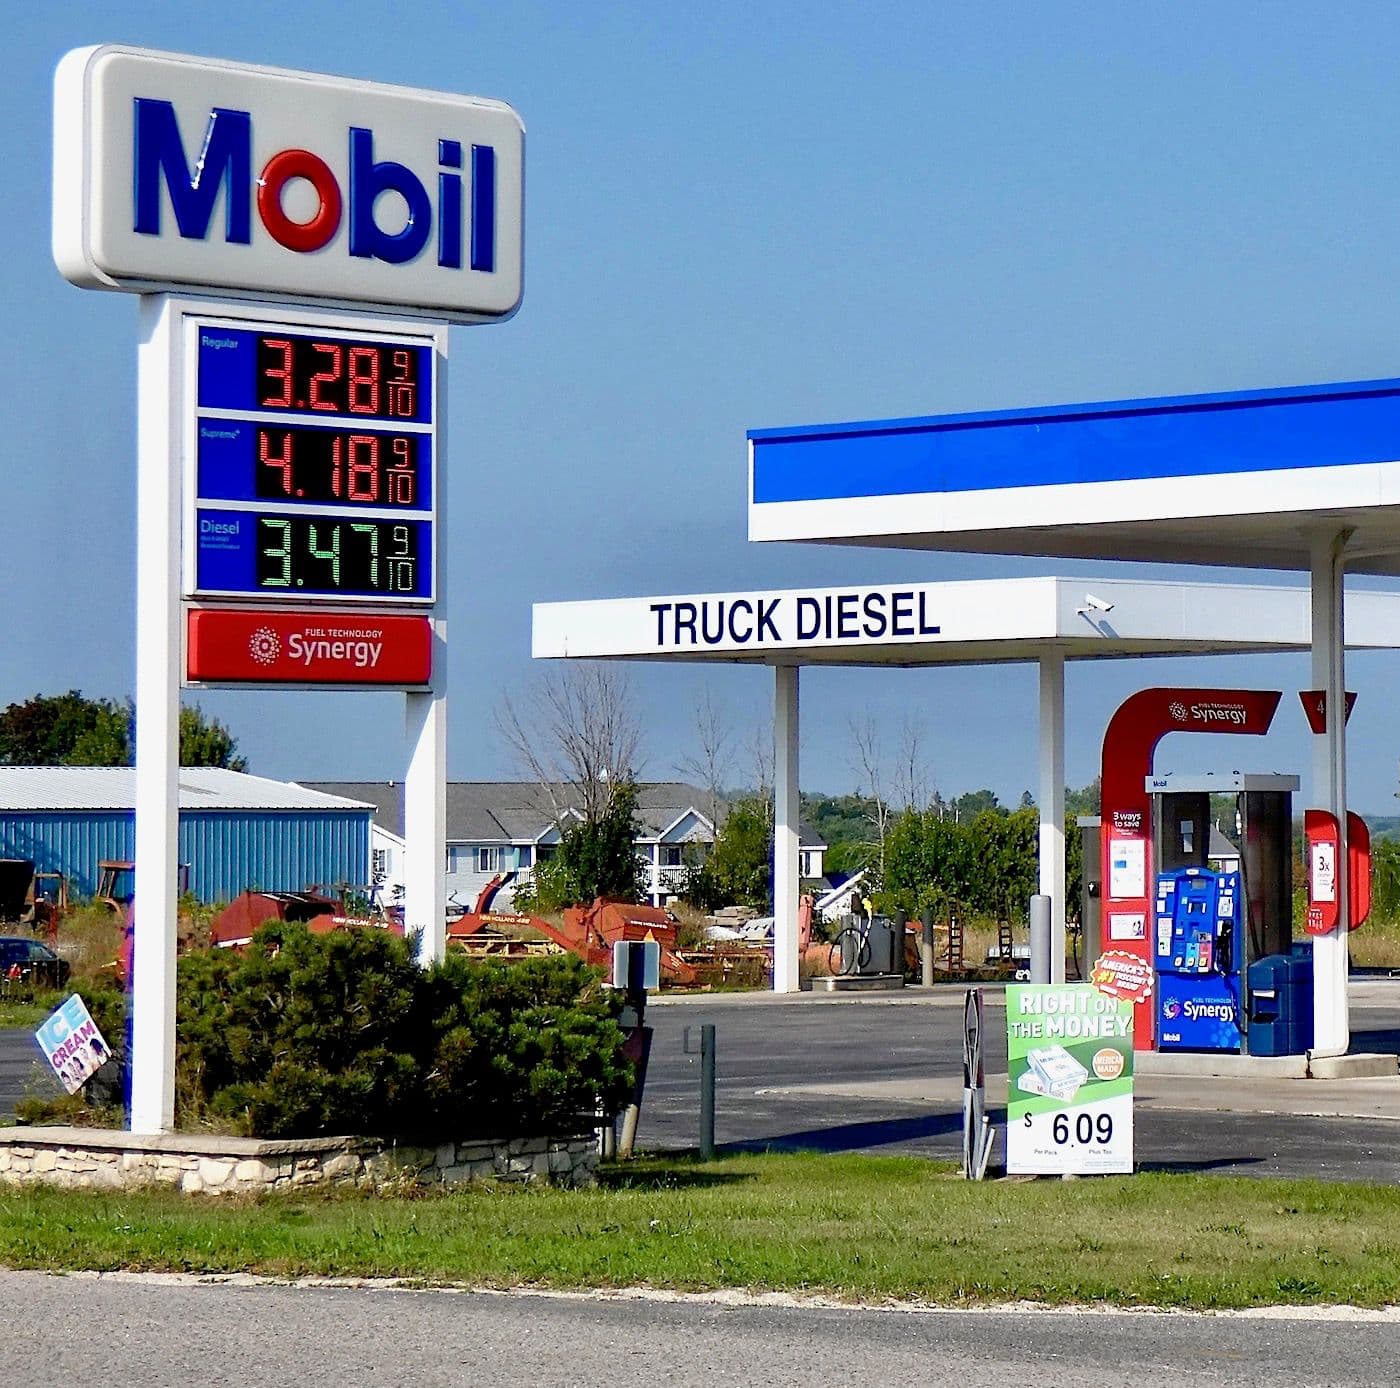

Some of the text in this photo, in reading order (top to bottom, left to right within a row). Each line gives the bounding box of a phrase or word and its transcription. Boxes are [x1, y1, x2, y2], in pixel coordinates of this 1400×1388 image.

[133, 97, 496, 272] Mobil
[202, 335, 238, 350] Regular
[262, 339, 379, 414] 3.28
[260, 431, 378, 502] 4.18
[200, 519, 240, 535] Diesel
[261, 519, 378, 587] 3.47
[650, 591, 941, 646] TRUCK DIESEL
[305, 628, 383, 639] FUEL TECHNOLOGY
[288, 633, 383, 668] Synergy
[1190, 705, 1246, 724] Synergy
[1113, 811, 1142, 823] 3 ways
[1114, 820, 1122, 828] to
[1318, 855, 1330, 872] 3x
[1229, 877, 1236, 888] 4
[1097, 970, 1116, 983] #1
[1101, 960, 1146, 977] AMERICA'S
[1019, 991, 1119, 1015] RIGHT ON
[1183, 1000, 1234, 1022] Synergy
[38, 999, 88, 1054] ICE
[1011, 1015, 1133, 1039] THE MONEY
[1163, 1033, 1181, 1042] Mobil
[52, 1020, 96, 1069] CREAM
[1053, 1113, 1113, 1148] 6.09
